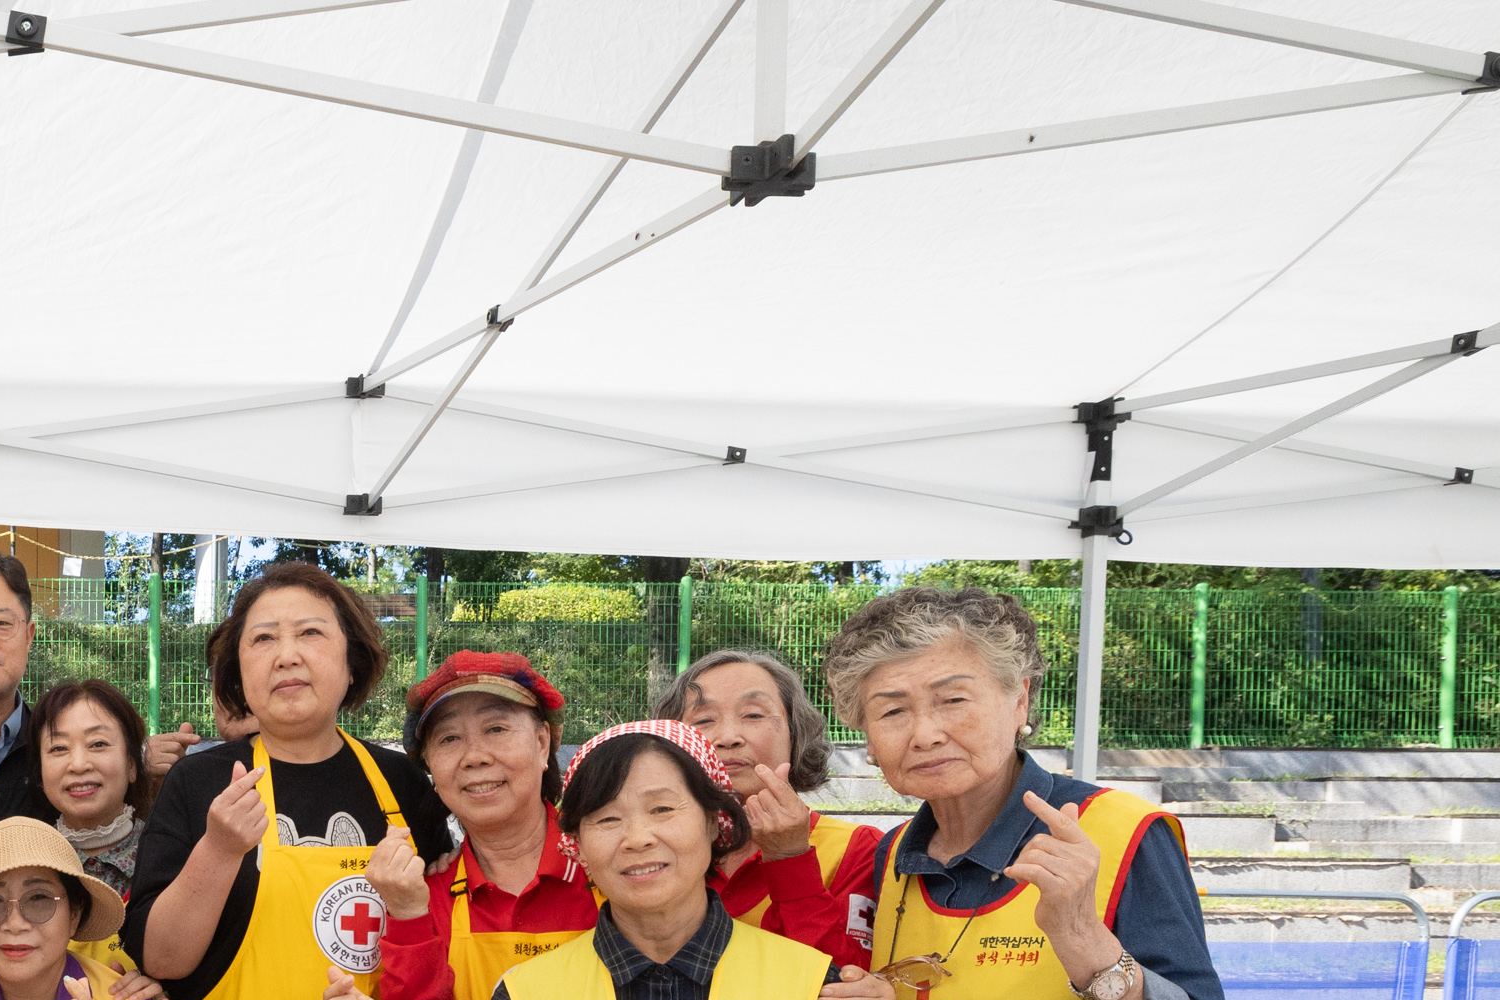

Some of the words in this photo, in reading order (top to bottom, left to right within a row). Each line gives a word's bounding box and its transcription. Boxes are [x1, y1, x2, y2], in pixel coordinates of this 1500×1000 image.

[321, 884, 353, 922] KOREAN
[356, 882, 377, 895] RED
[979, 936, 1046, 948] 대한적십자사
